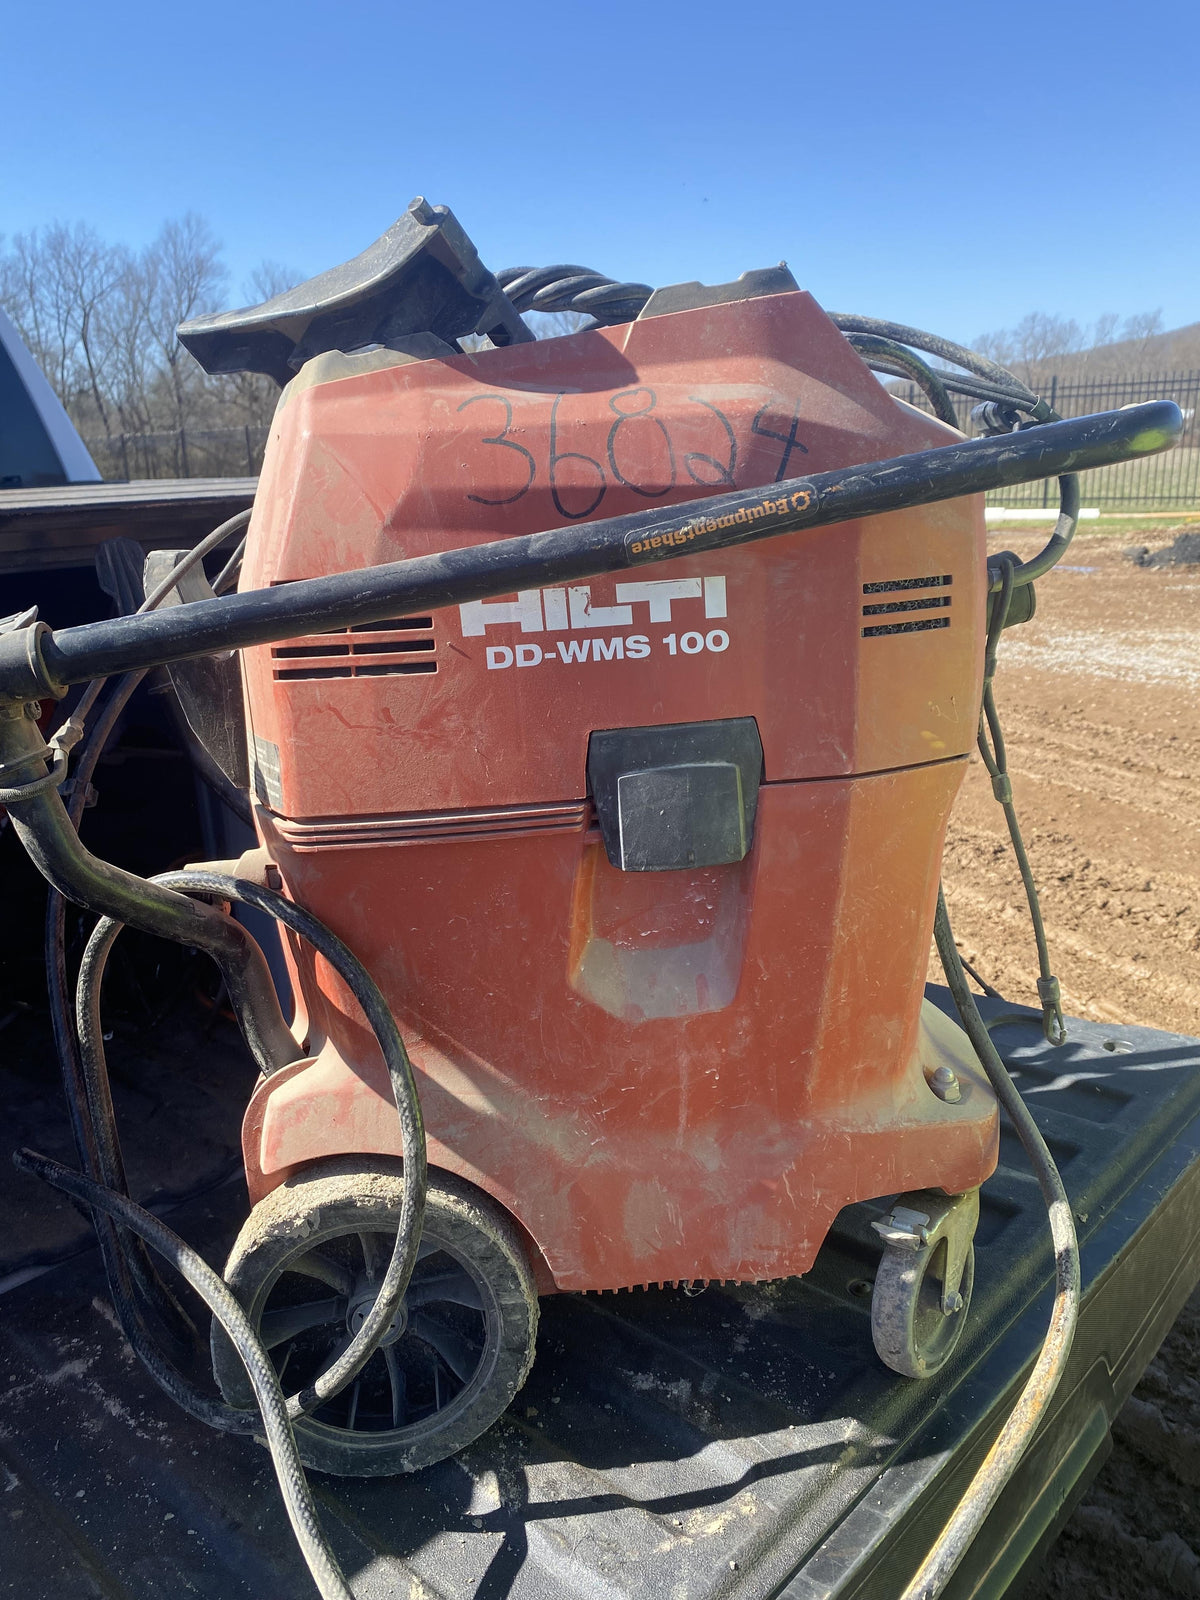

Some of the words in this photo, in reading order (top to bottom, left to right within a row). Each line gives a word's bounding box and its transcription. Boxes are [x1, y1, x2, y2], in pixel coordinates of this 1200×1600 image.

[631, 497, 789, 554] EquipmentShare
[459, 575, 727, 637] HILTI
[485, 634, 651, 670] DD-WMS
[662, 629, 730, 656] 100
